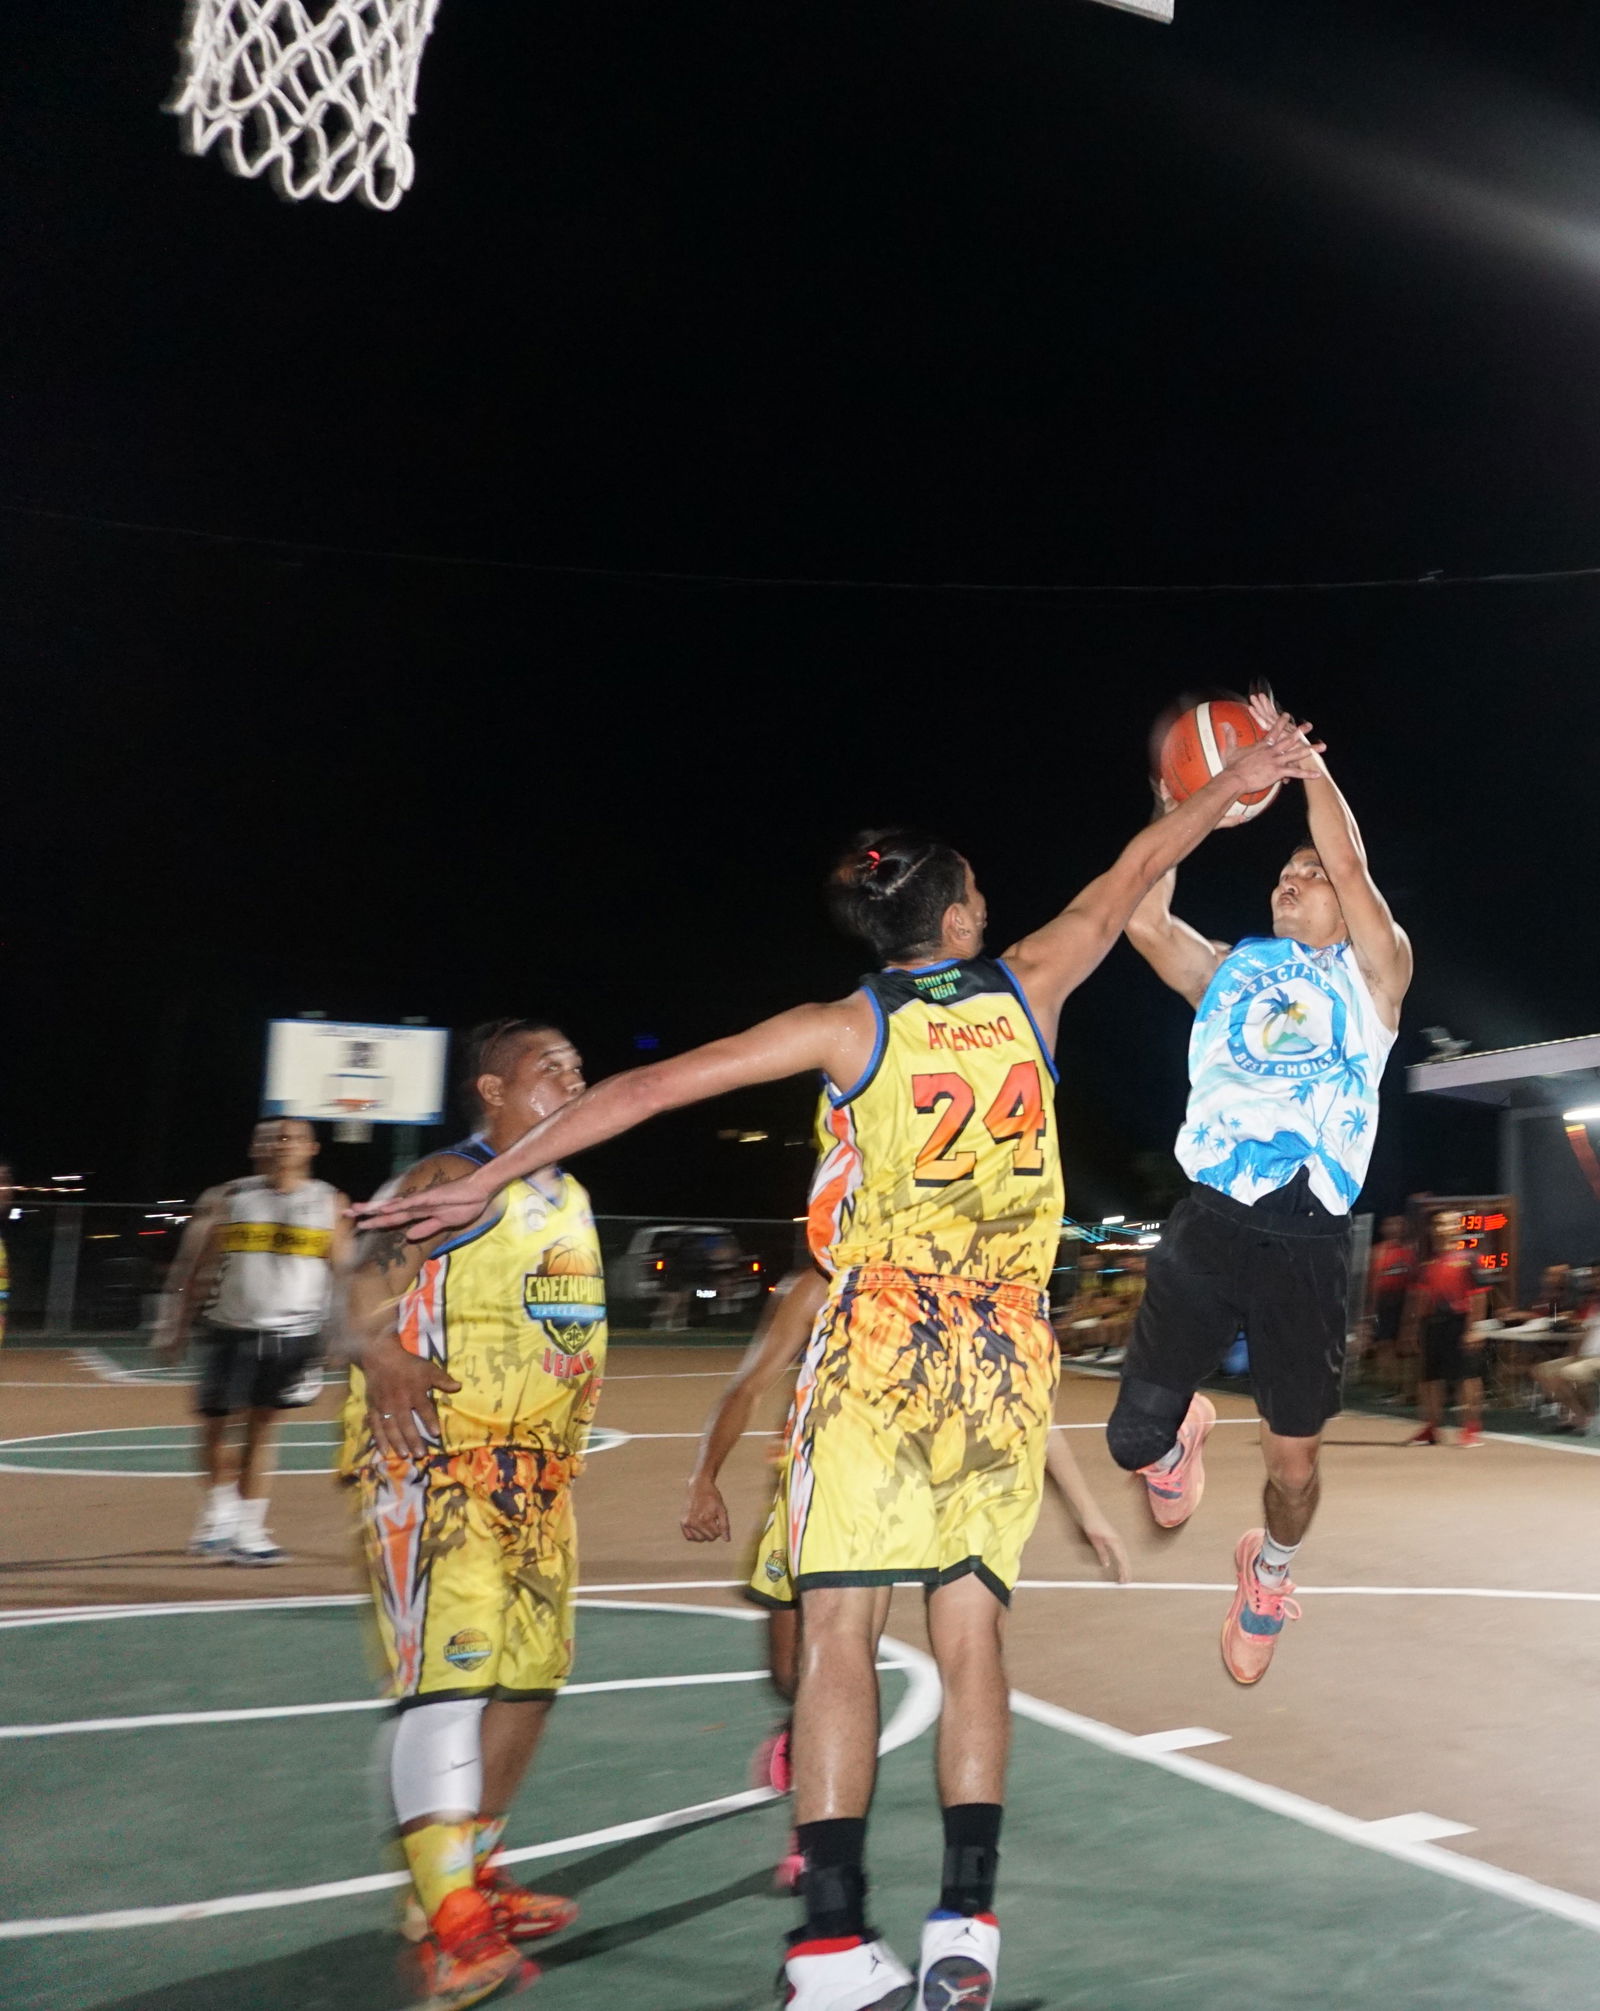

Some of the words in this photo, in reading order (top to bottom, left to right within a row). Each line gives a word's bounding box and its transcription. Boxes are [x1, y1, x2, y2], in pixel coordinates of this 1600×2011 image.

[1247, 964, 1330, 994] PACIFIC
[928, 1016, 1015, 1051] ATENCIO
[1234, 1052, 1269, 1074] BEST
[1274, 1054, 1334, 1076] CHOICE
[912, 1060, 1046, 1187] 24
[525, 1275, 604, 1304] CHECKPO
